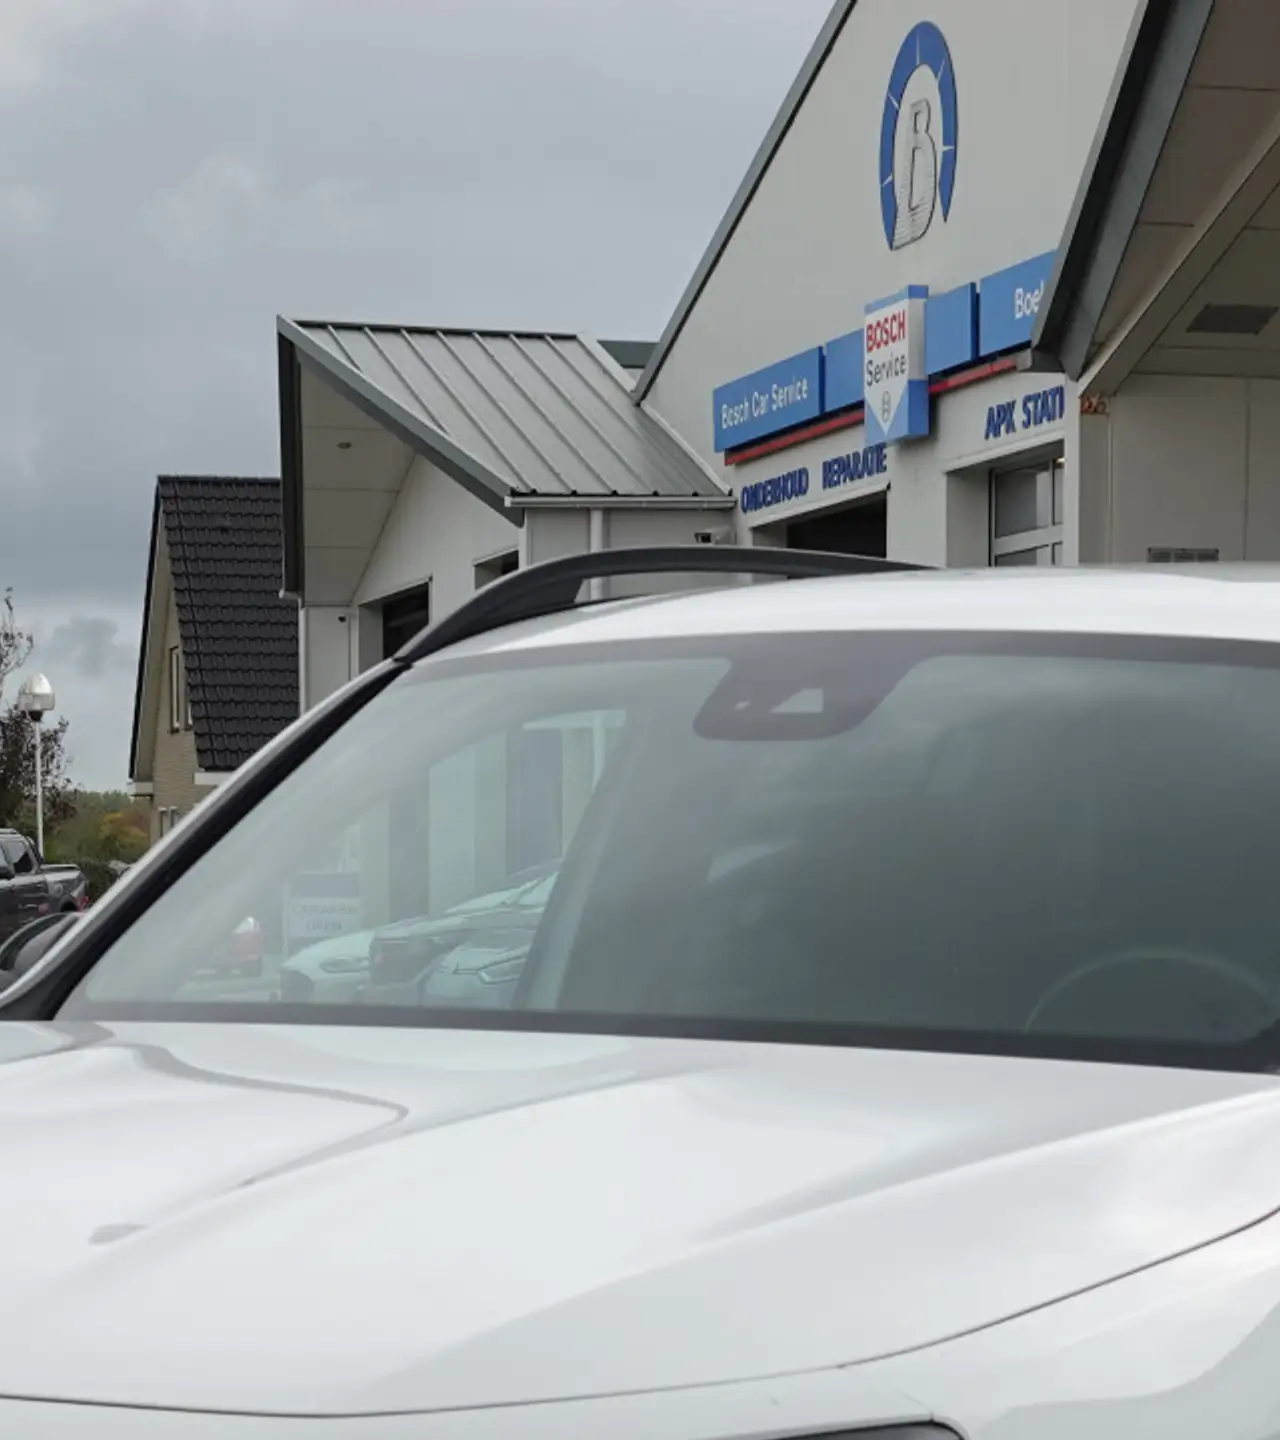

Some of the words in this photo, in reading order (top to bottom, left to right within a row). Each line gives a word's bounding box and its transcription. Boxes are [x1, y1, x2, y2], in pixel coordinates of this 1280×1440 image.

[866, 310, 906, 352] BOSCH
[866, 352, 906, 387] Service
[721, 395, 748, 429] Bosch
[751, 391, 769, 417] Car
[772, 376, 808, 411] Service
[984, 398, 1017, 441] APK
[740, 467, 809, 514] ONDERHOUD
[822, 442, 887, 490] REPARATIE
